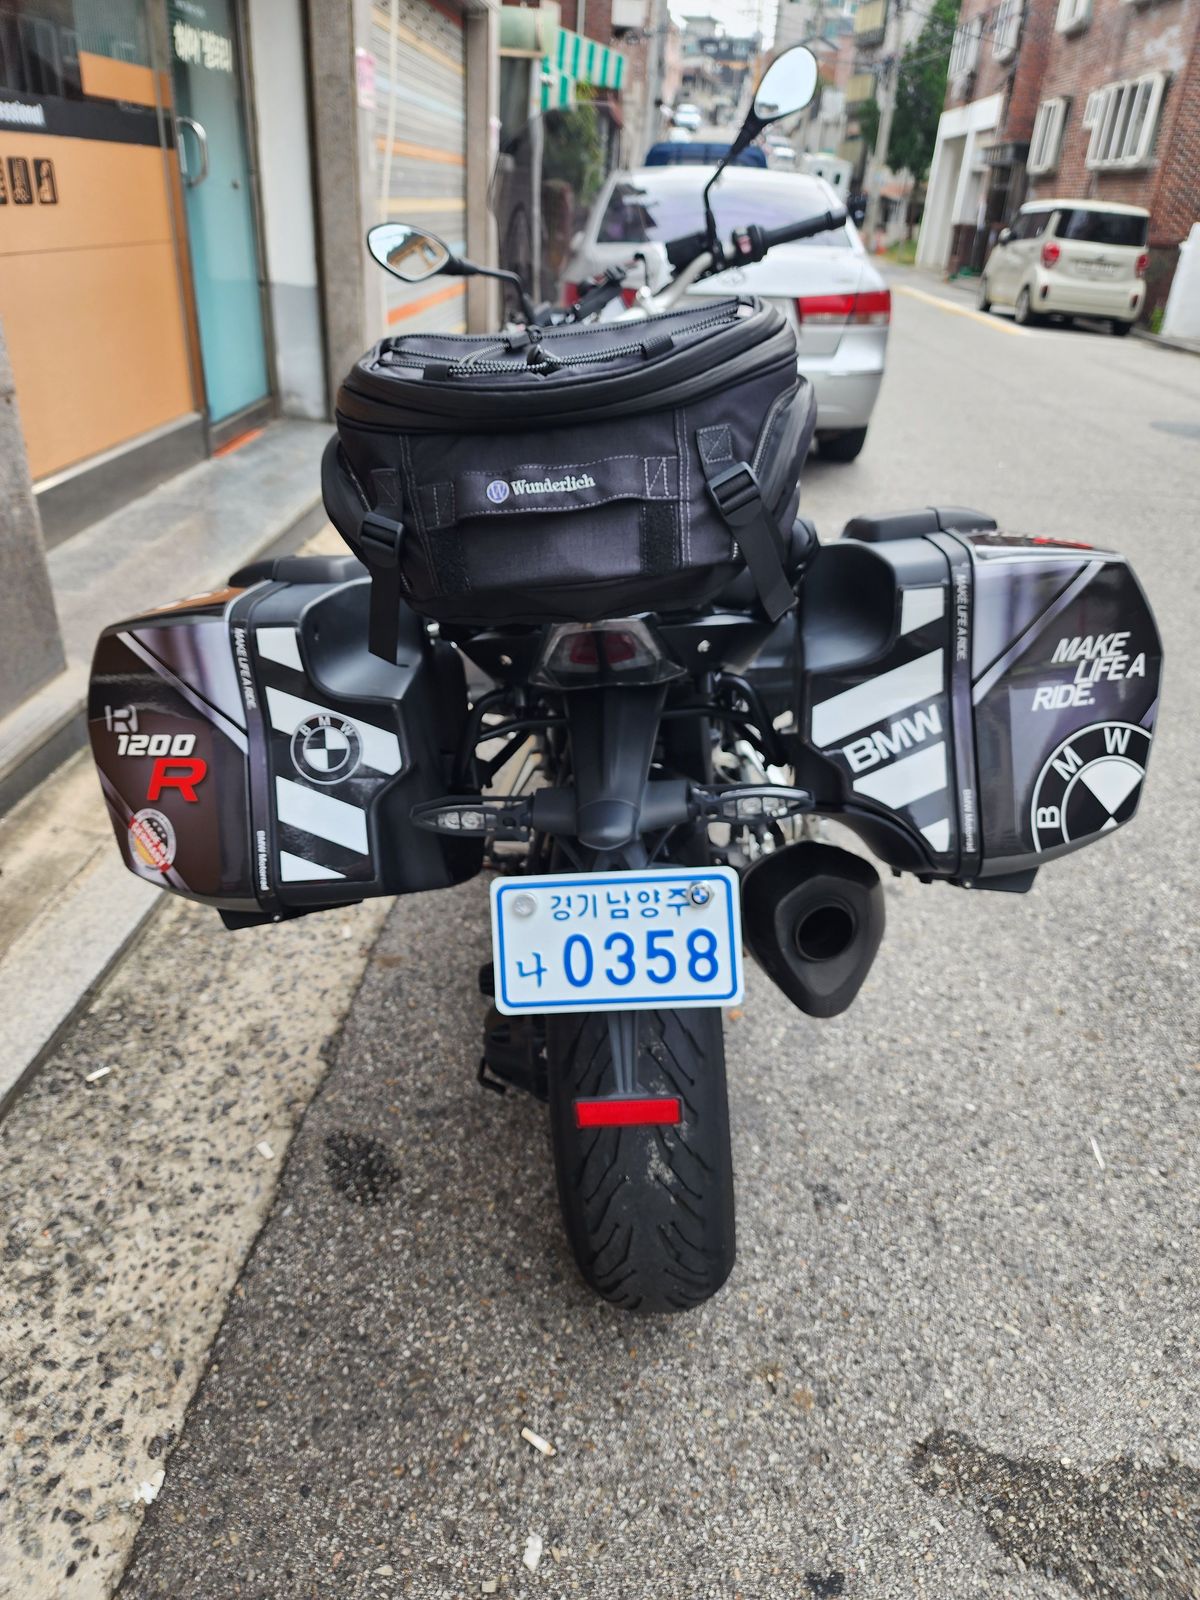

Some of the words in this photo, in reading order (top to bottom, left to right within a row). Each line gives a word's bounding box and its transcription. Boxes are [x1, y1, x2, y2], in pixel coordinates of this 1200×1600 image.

[510, 474, 596, 496] Wunderlich
[1051, 631, 1131, 663] MAKE
[1073, 654, 1130, 684] LIFE
[1125, 652, 1145, 679] A
[1031, 683, 1096, 711] RIDE.
[117, 734, 197, 757] 1200
[841, 703, 944, 774] BMW
[146, 756, 208, 802] R
[1036, 726, 1132, 829] BMW
[256, 830, 267, 852] BMW
[515, 951, 548, 988] 나
[562, 928, 720, 988] 0358
